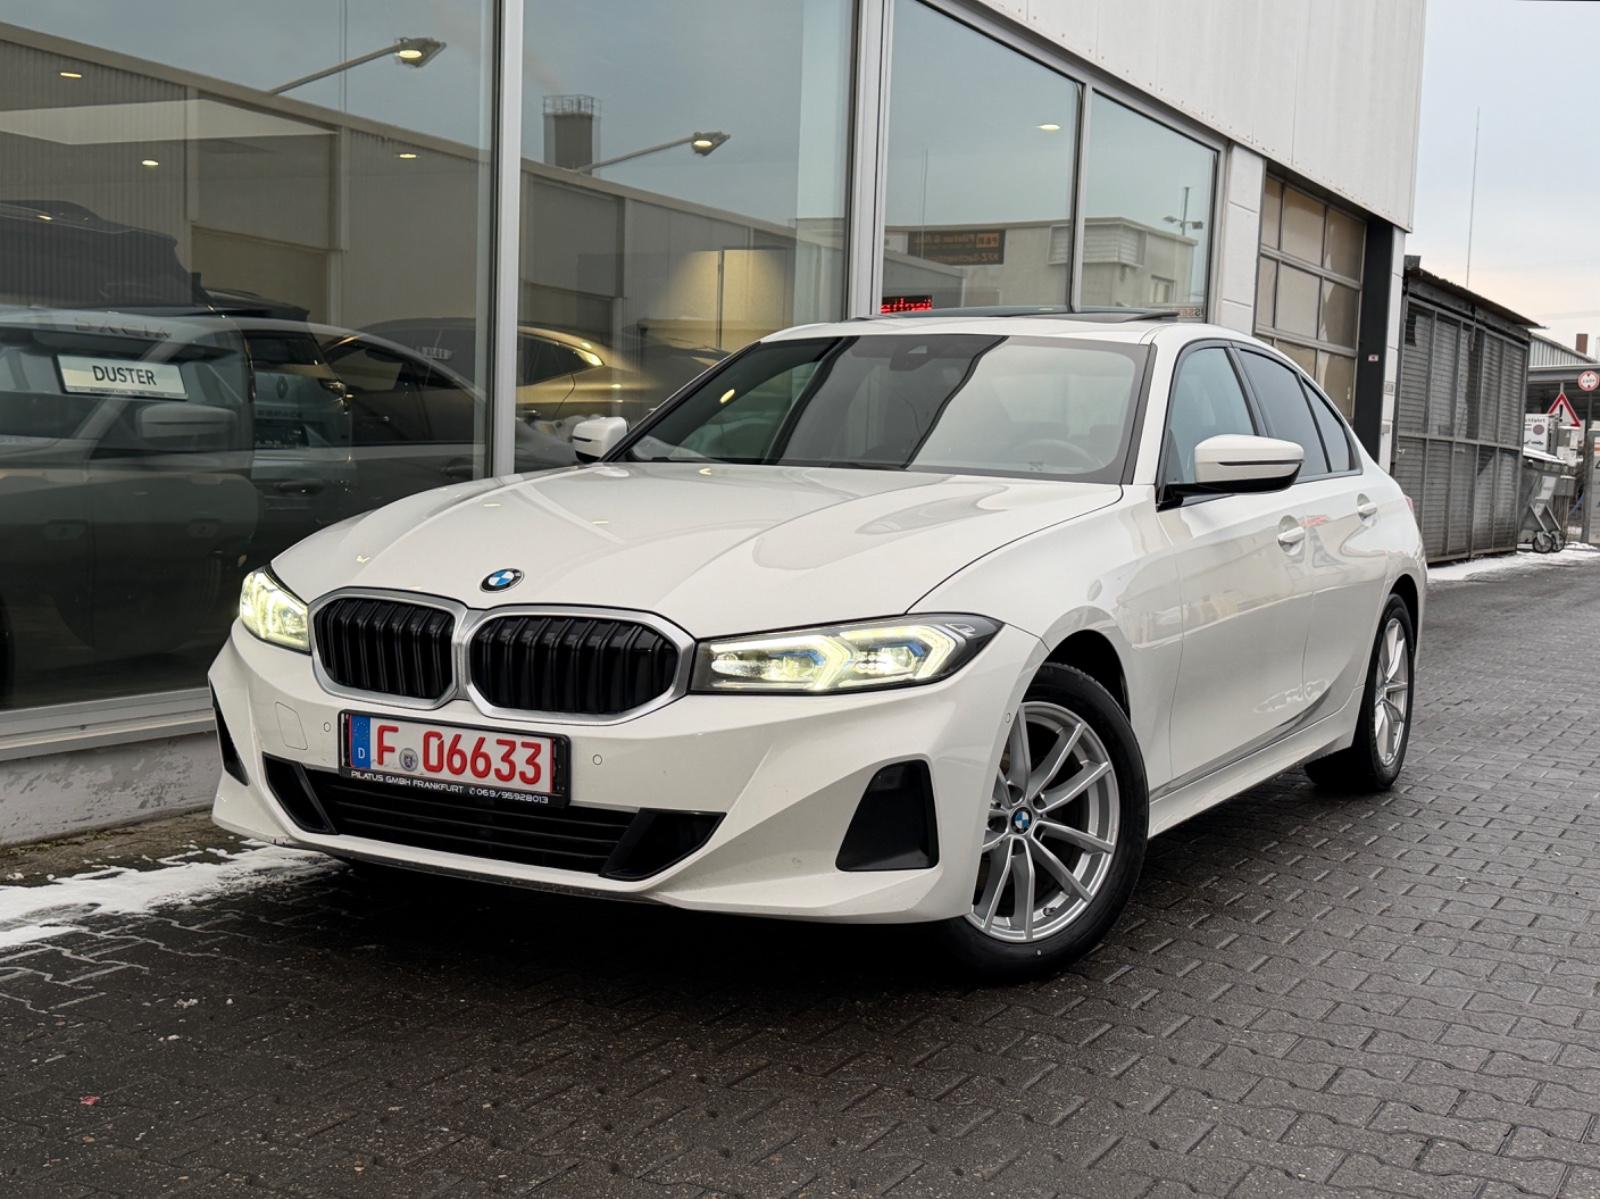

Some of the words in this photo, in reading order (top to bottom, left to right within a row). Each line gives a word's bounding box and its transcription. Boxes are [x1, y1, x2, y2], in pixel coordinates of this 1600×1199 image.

[92, 365, 157, 385] DUSTER
[357, 747, 366, 759] D
[377, 725, 399, 766] F
[422, 731, 542, 785] 06633
[351, 771, 384, 783] PILATUS
[385, 776, 411, 786] GMBH
[413, 780, 464, 794] FRANKFURT
